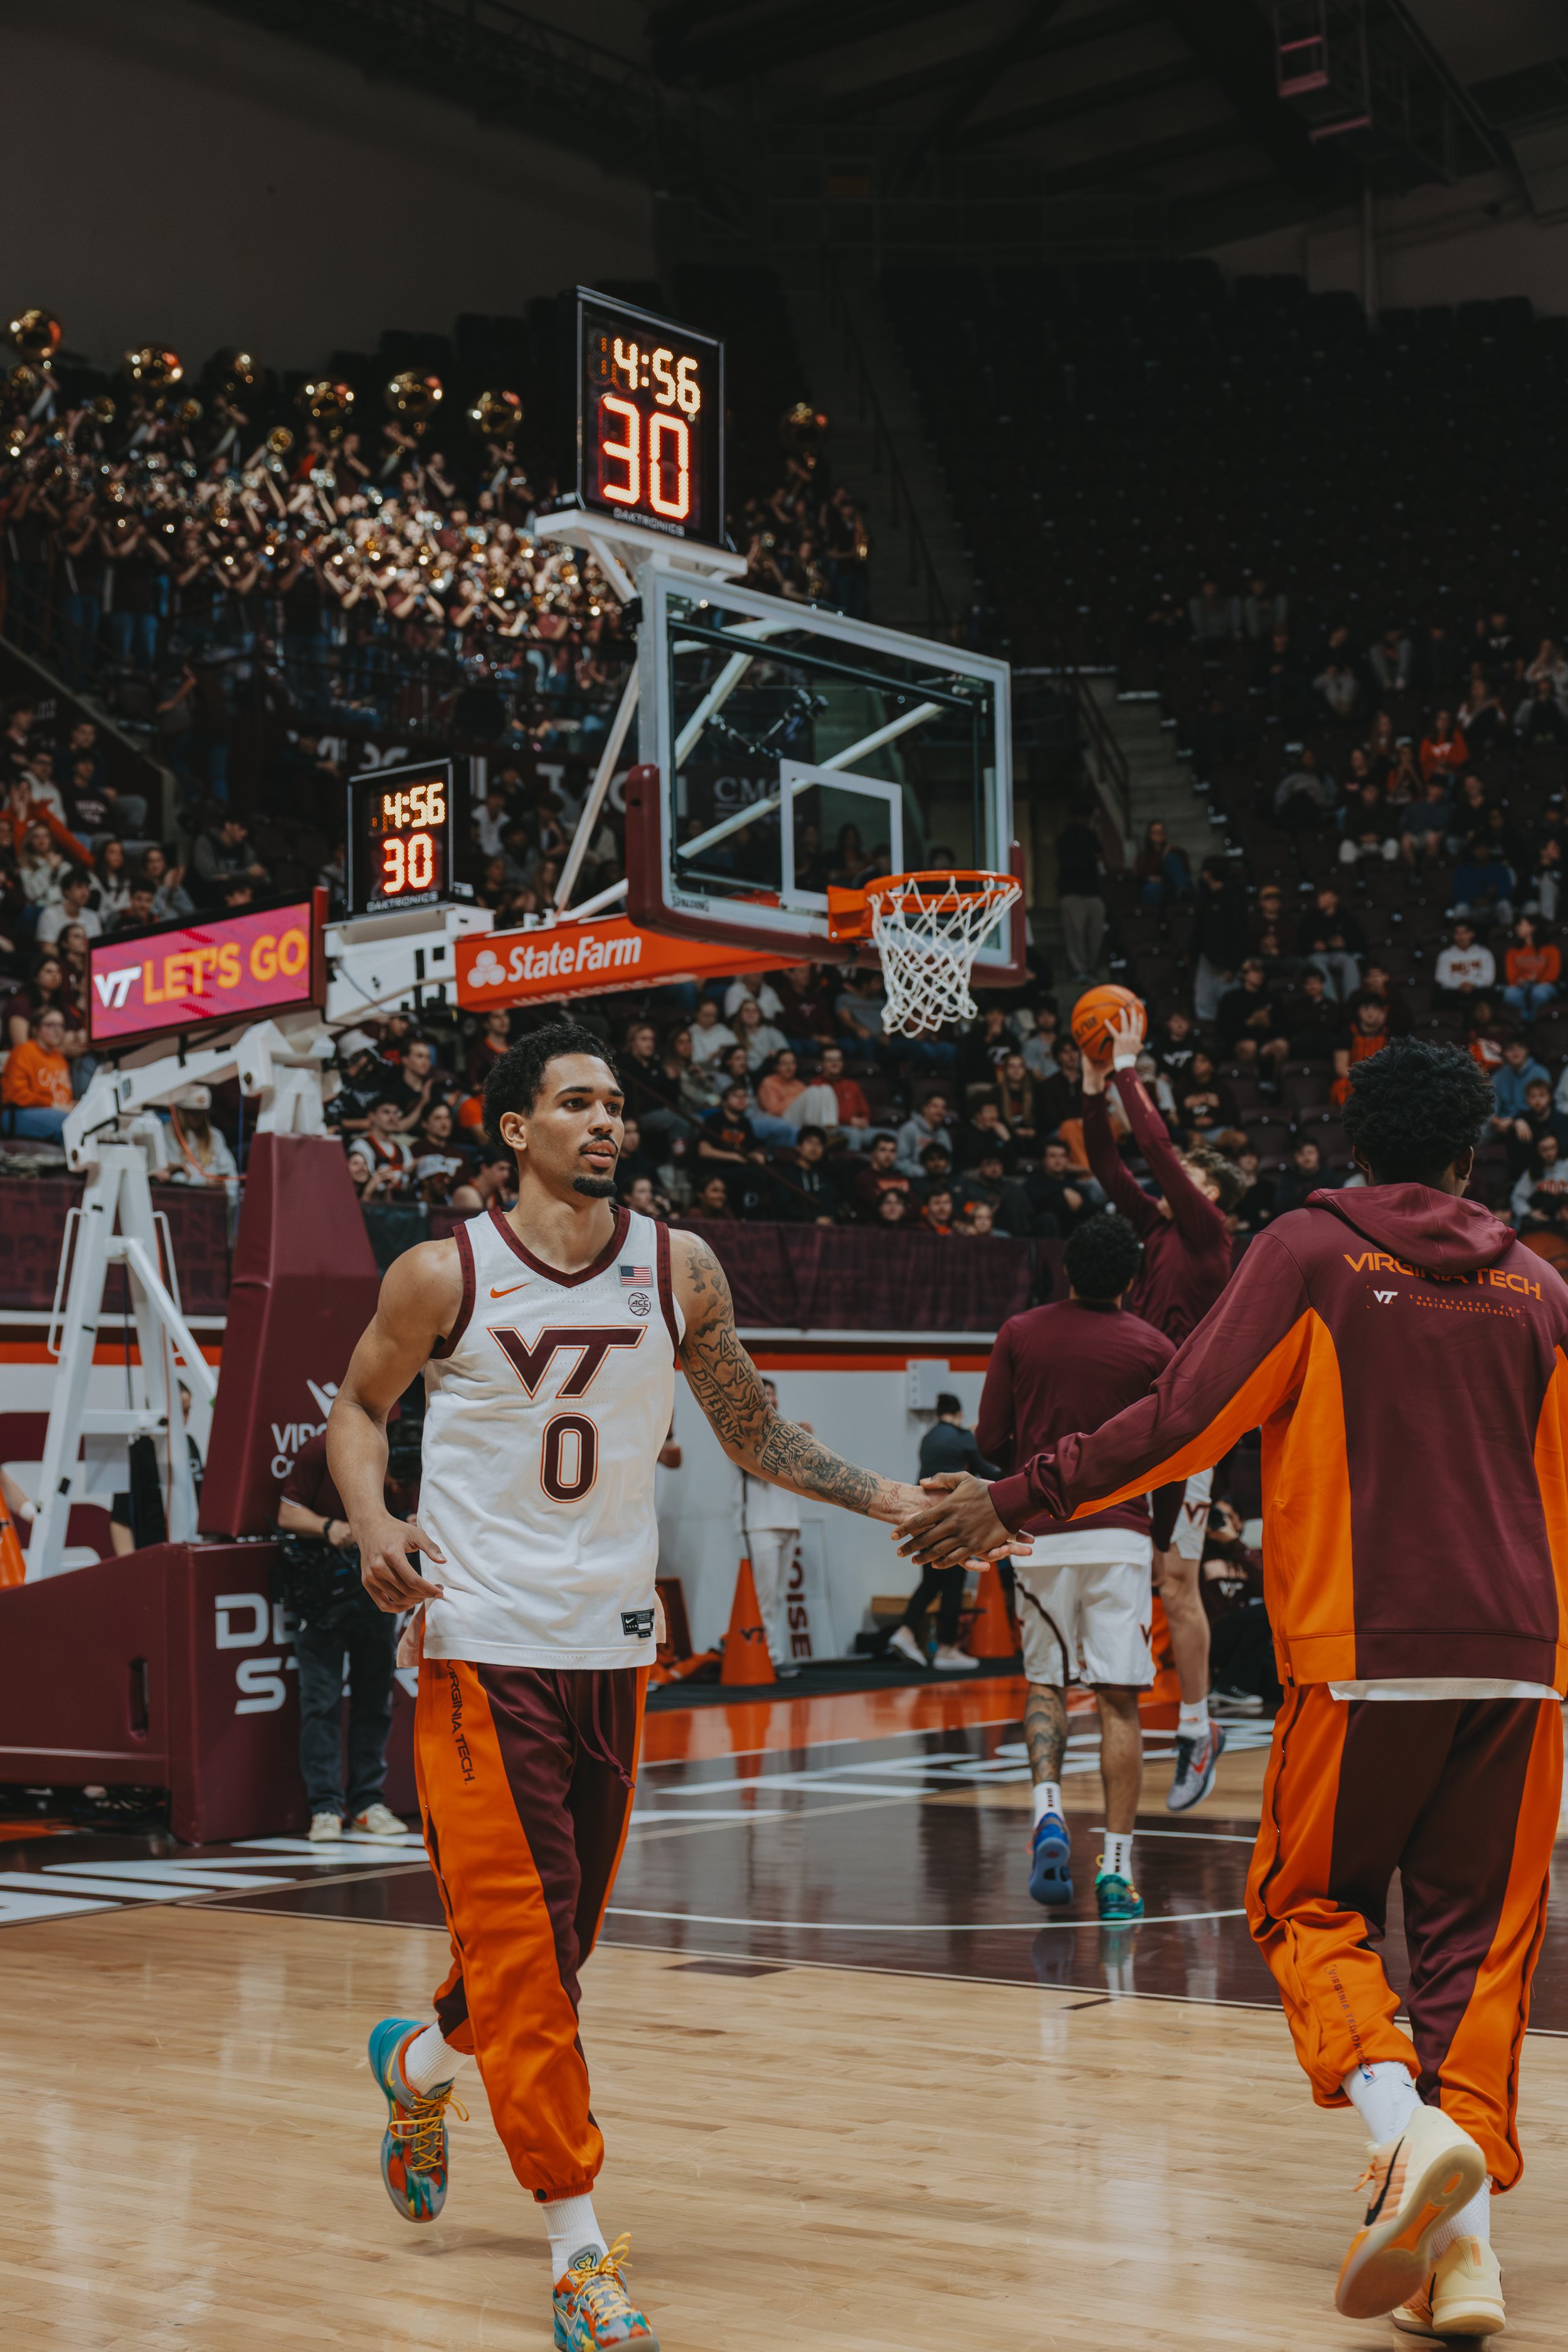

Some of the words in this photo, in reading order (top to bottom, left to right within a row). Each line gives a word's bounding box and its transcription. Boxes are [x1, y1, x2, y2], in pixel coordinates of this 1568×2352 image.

[613, 338, 700, 414] 4:56
[603, 395, 689, 519] 30
[613, 507, 685, 538] DAKTRONICS
[384, 783, 445, 828] 4:56
[383, 833, 433, 893] 30
[366, 890, 439, 913] DAKTRONICS
[94, 966, 142, 1009] VT
[143, 942, 242, 1005] LET'S
[250, 928, 309, 982] GO
[1372, 1290, 1399, 1305] VT
[1475, 1268, 1541, 1301] TECH
[487, 1325, 649, 1401] VT
[540, 1412, 599, 1504] 0
[446, 1659, 463, 1734] VIRGINIA
[455, 1733, 475, 1783] TECH
